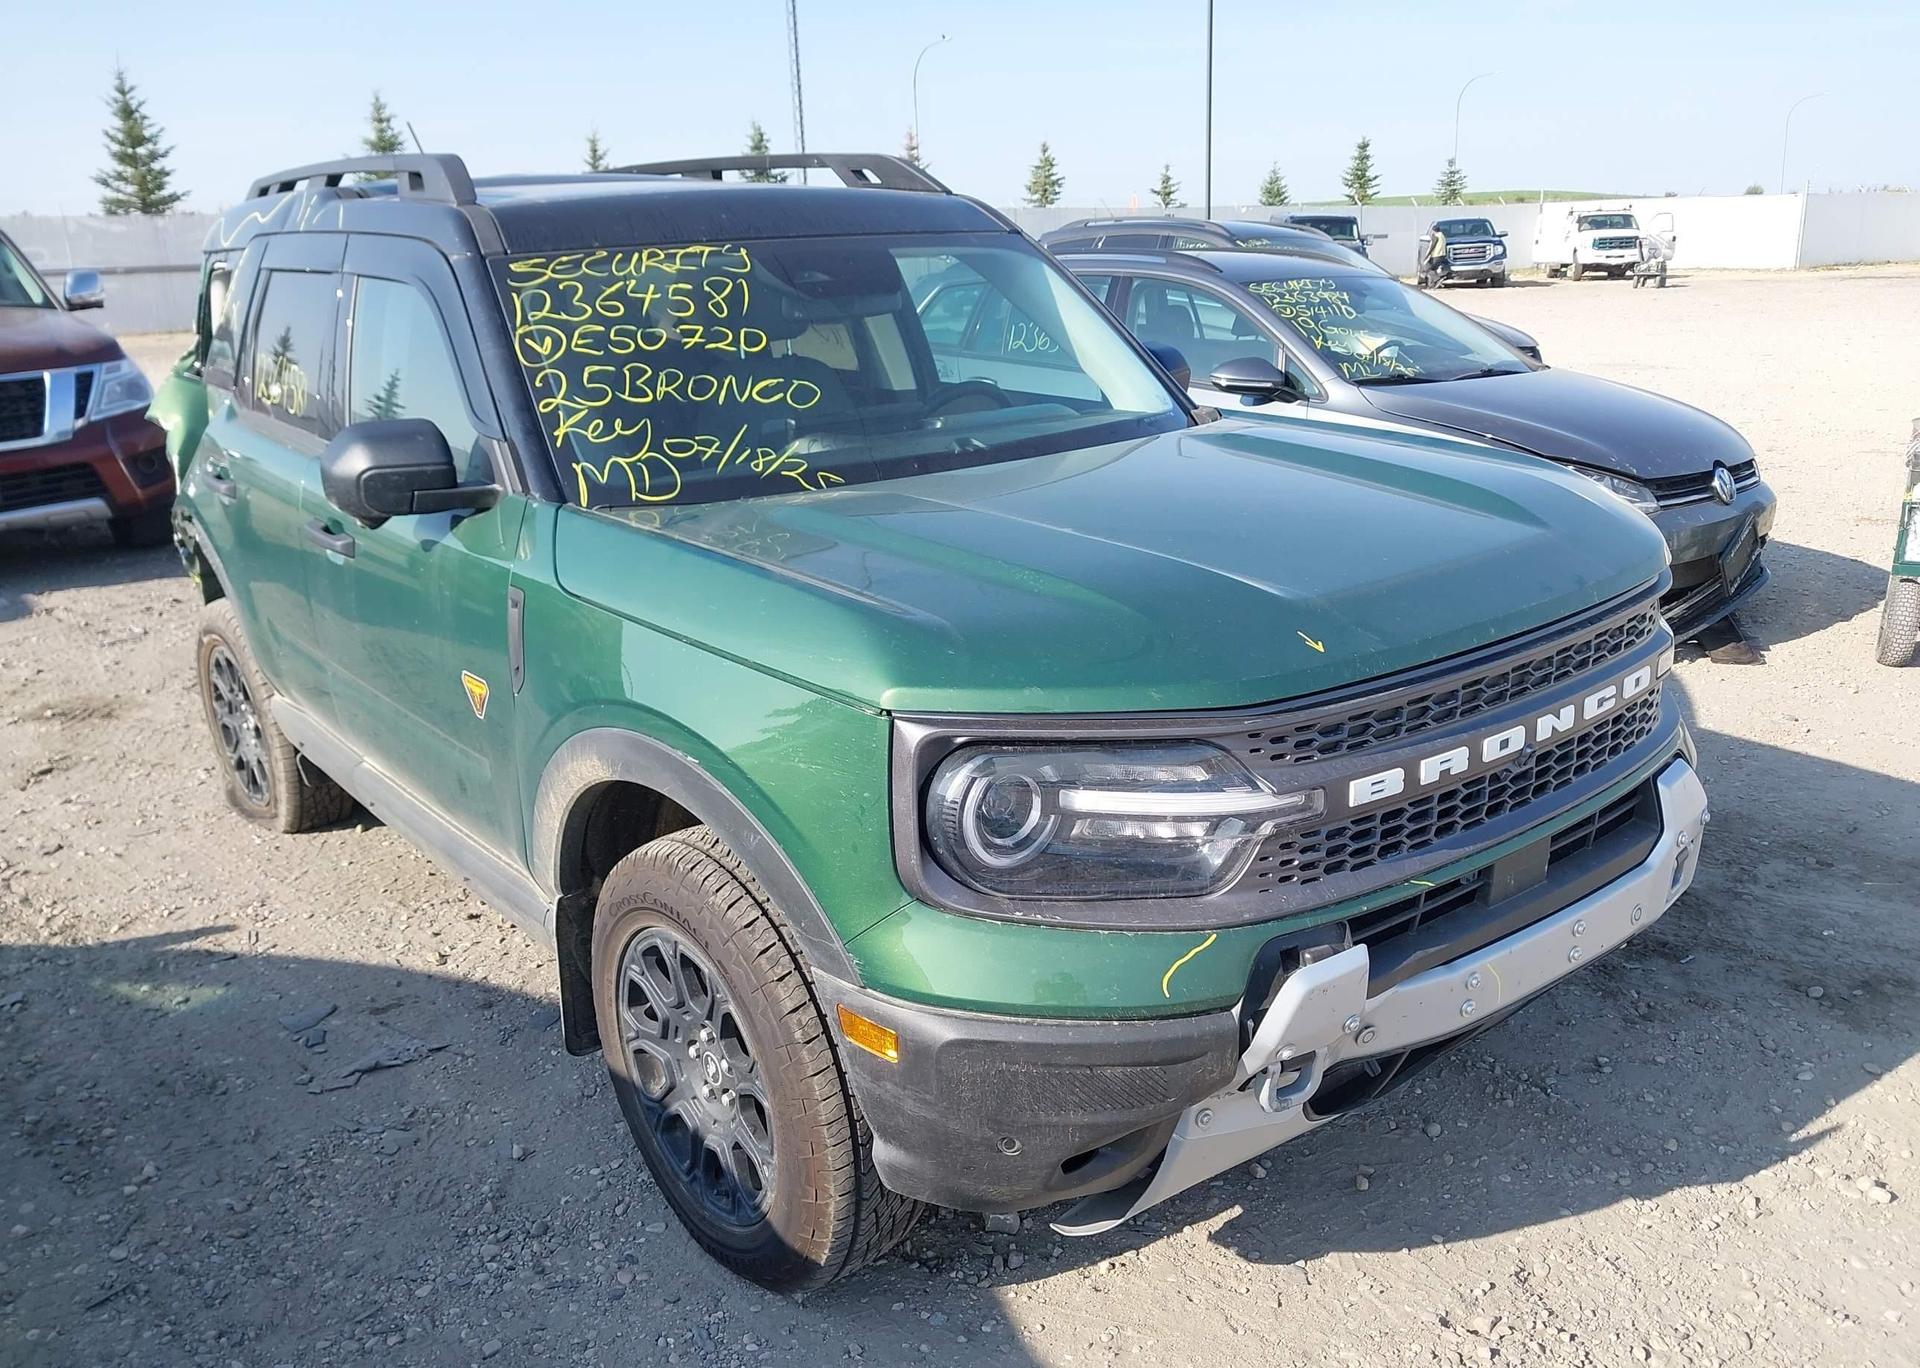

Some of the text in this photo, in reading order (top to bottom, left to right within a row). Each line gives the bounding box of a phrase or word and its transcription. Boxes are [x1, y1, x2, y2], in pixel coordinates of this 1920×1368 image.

[507, 244, 751, 287] SECURITY
[511, 276, 750, 327] 12364581
[1008, 322, 1060, 353] 1236
[553, 408, 652, 463] Key
[1349, 665, 1651, 808] BRONCO
